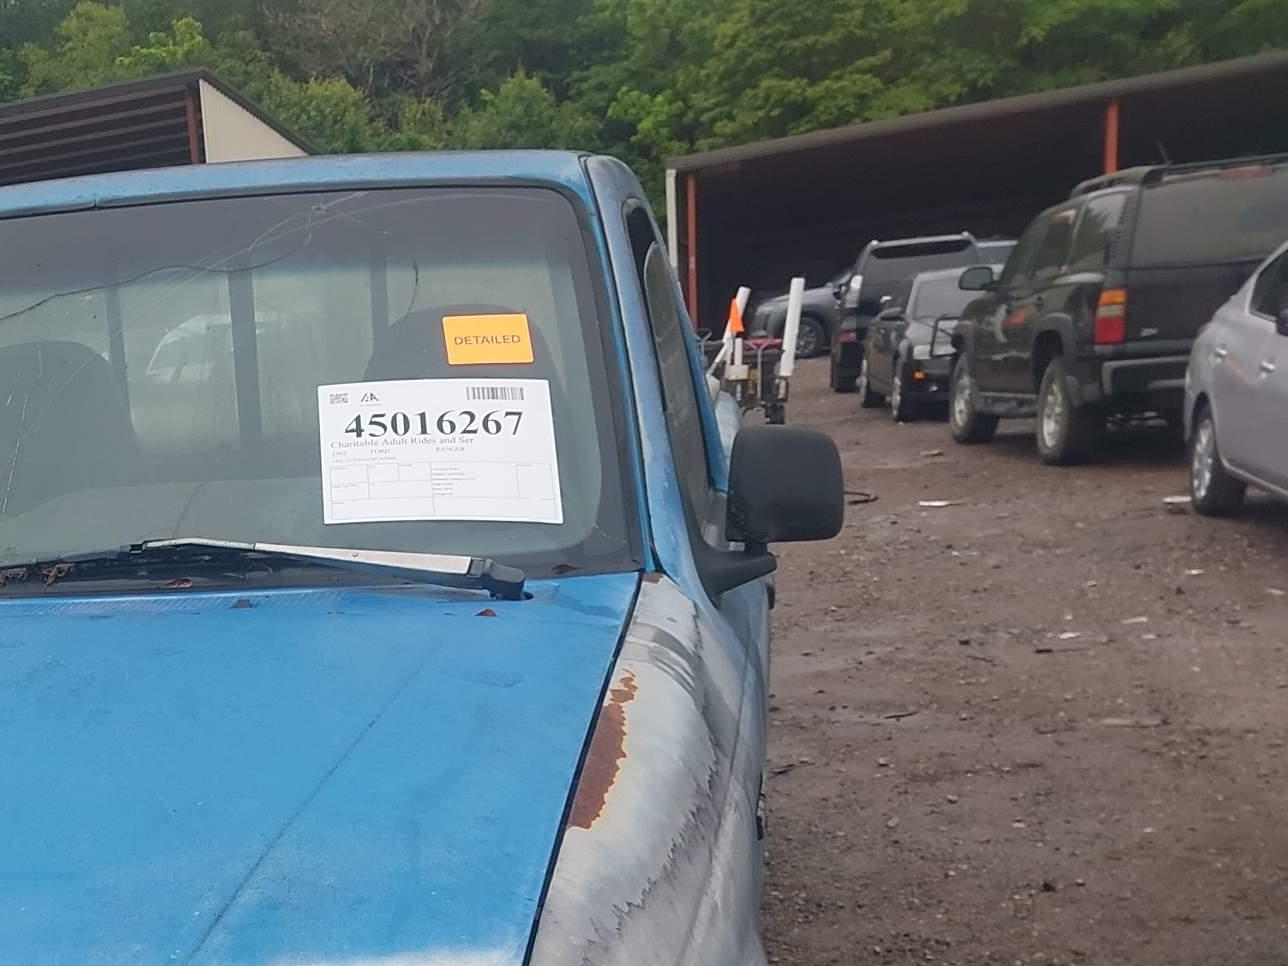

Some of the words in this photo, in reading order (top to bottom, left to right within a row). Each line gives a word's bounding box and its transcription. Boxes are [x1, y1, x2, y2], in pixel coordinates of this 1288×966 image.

[453, 334, 521, 346] DETAILED
[344, 410, 524, 438] 45016267
[330, 438, 379, 449] Charitable
[381, 437, 409, 446] Adult
[410, 436, 437, 445] Rides
[438, 436, 456, 445] and
[458, 435, 474, 444] Ser
